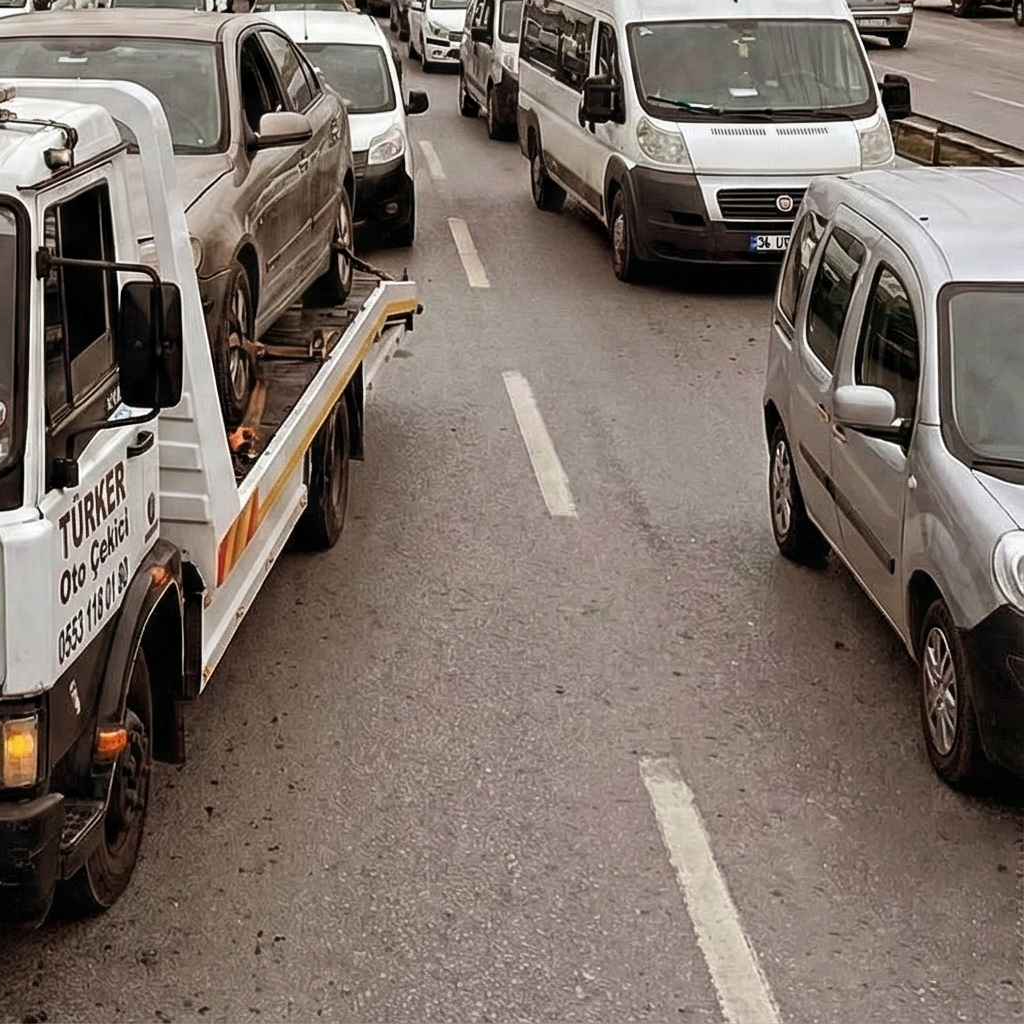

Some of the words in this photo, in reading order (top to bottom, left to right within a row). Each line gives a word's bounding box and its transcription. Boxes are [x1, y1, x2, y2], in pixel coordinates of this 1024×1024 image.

[59, 461, 126, 559] TÜRKER
[60, 562, 86, 605] Oto
[91, 507, 129, 581] Çekici
[58, 609, 83, 665] 0553
[87, 586, 103, 632] 118
